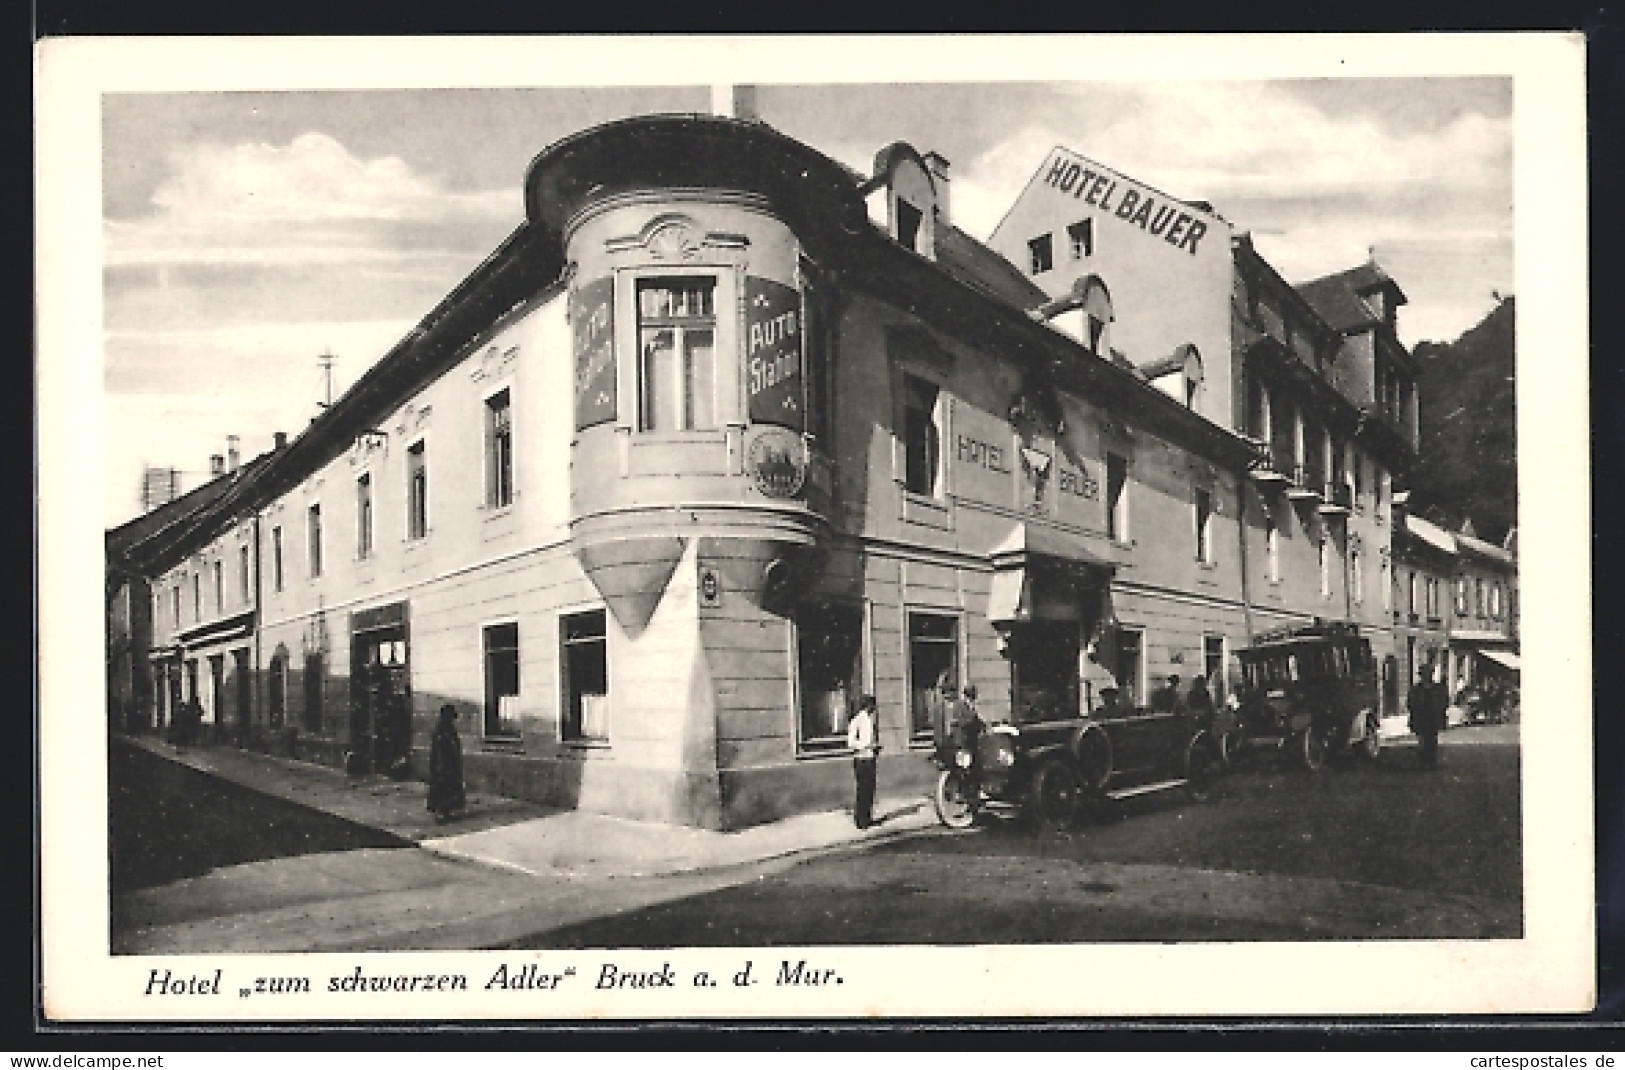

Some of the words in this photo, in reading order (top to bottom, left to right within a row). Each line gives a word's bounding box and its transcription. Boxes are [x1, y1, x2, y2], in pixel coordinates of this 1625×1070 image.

[1044, 156, 1116, 210] HOTEL
[1115, 189, 1207, 256] BAUER
[750, 310, 797, 356] AUTO
[957, 434, 1012, 475] HOTEL
